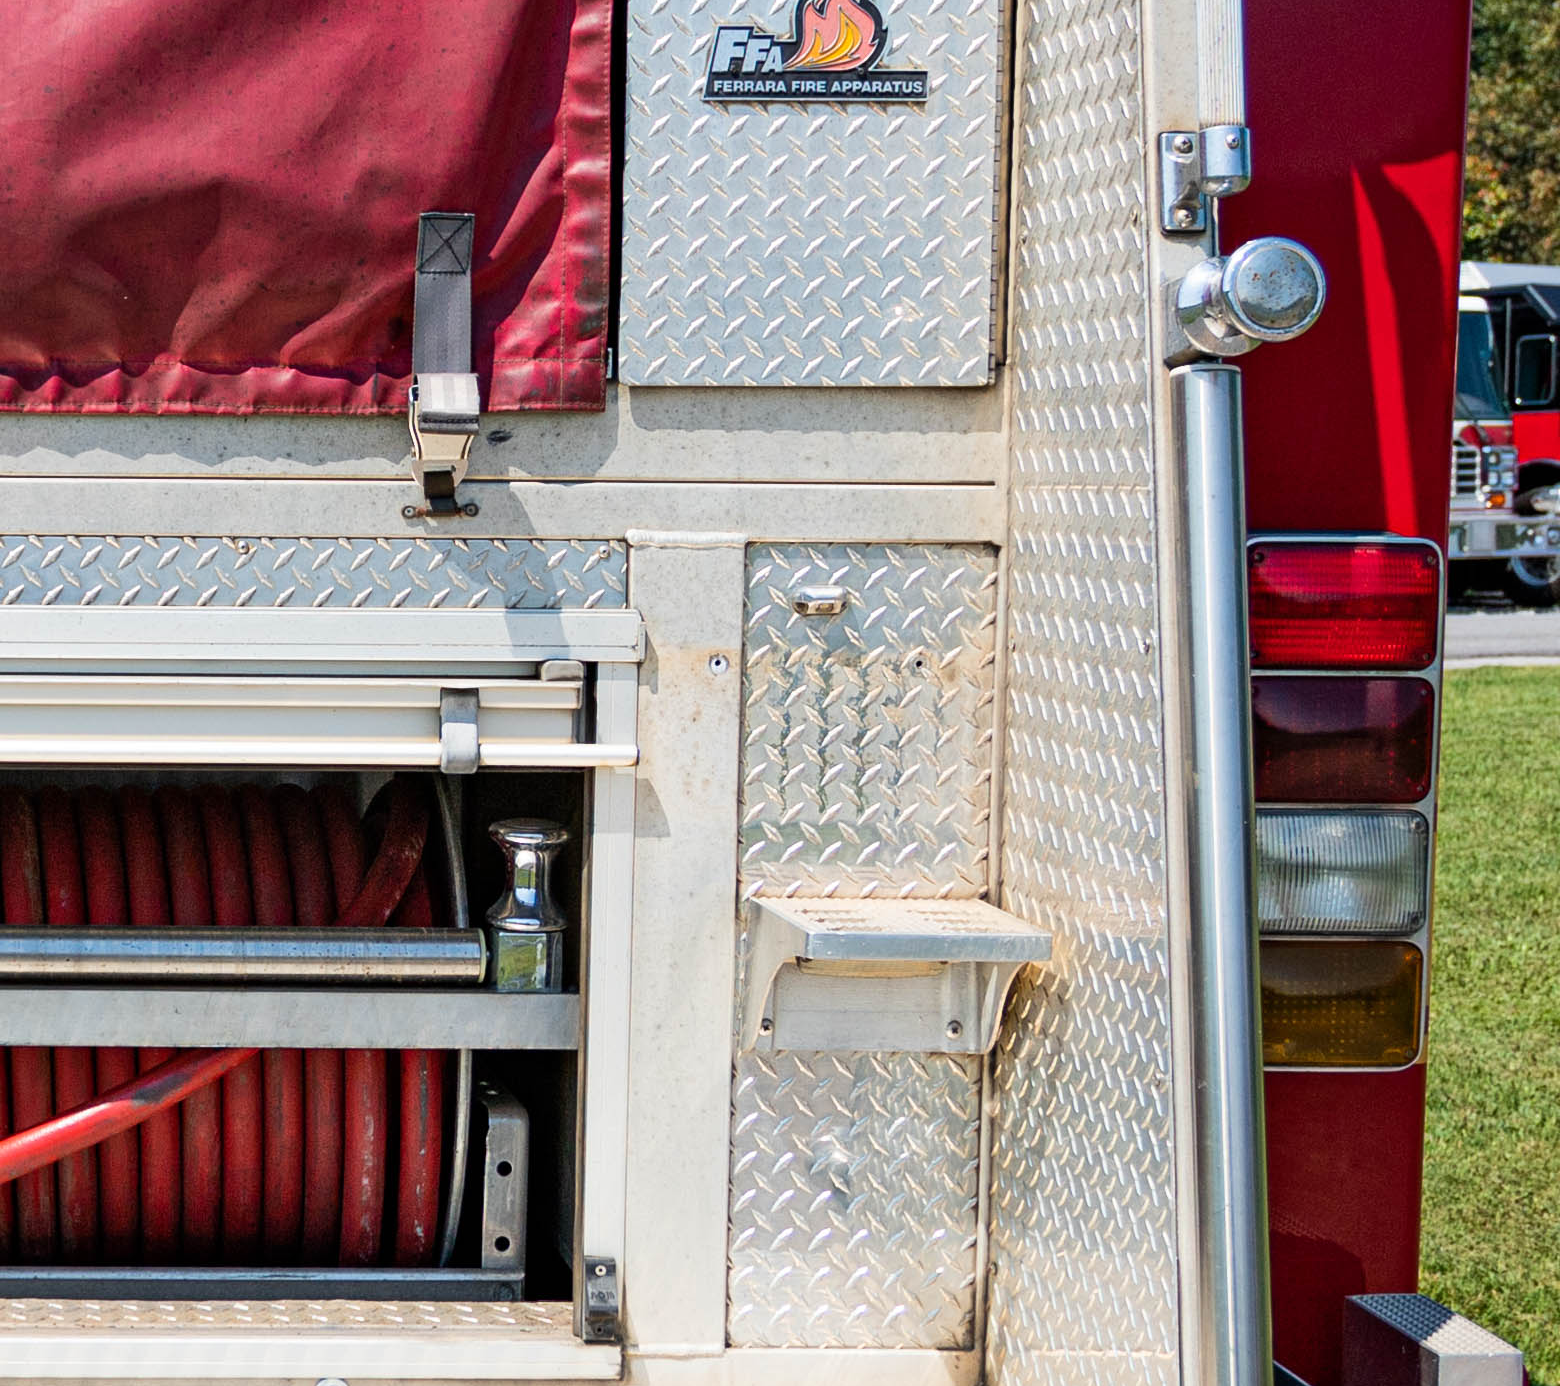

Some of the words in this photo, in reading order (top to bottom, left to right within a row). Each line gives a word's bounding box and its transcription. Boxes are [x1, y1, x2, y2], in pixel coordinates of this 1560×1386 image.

[711, 28, 785, 73] FFA
[713, 80, 786, 93] FERRARA
[791, 80, 827, 93] FIRE
[830, 80, 923, 93] APPARATUS
